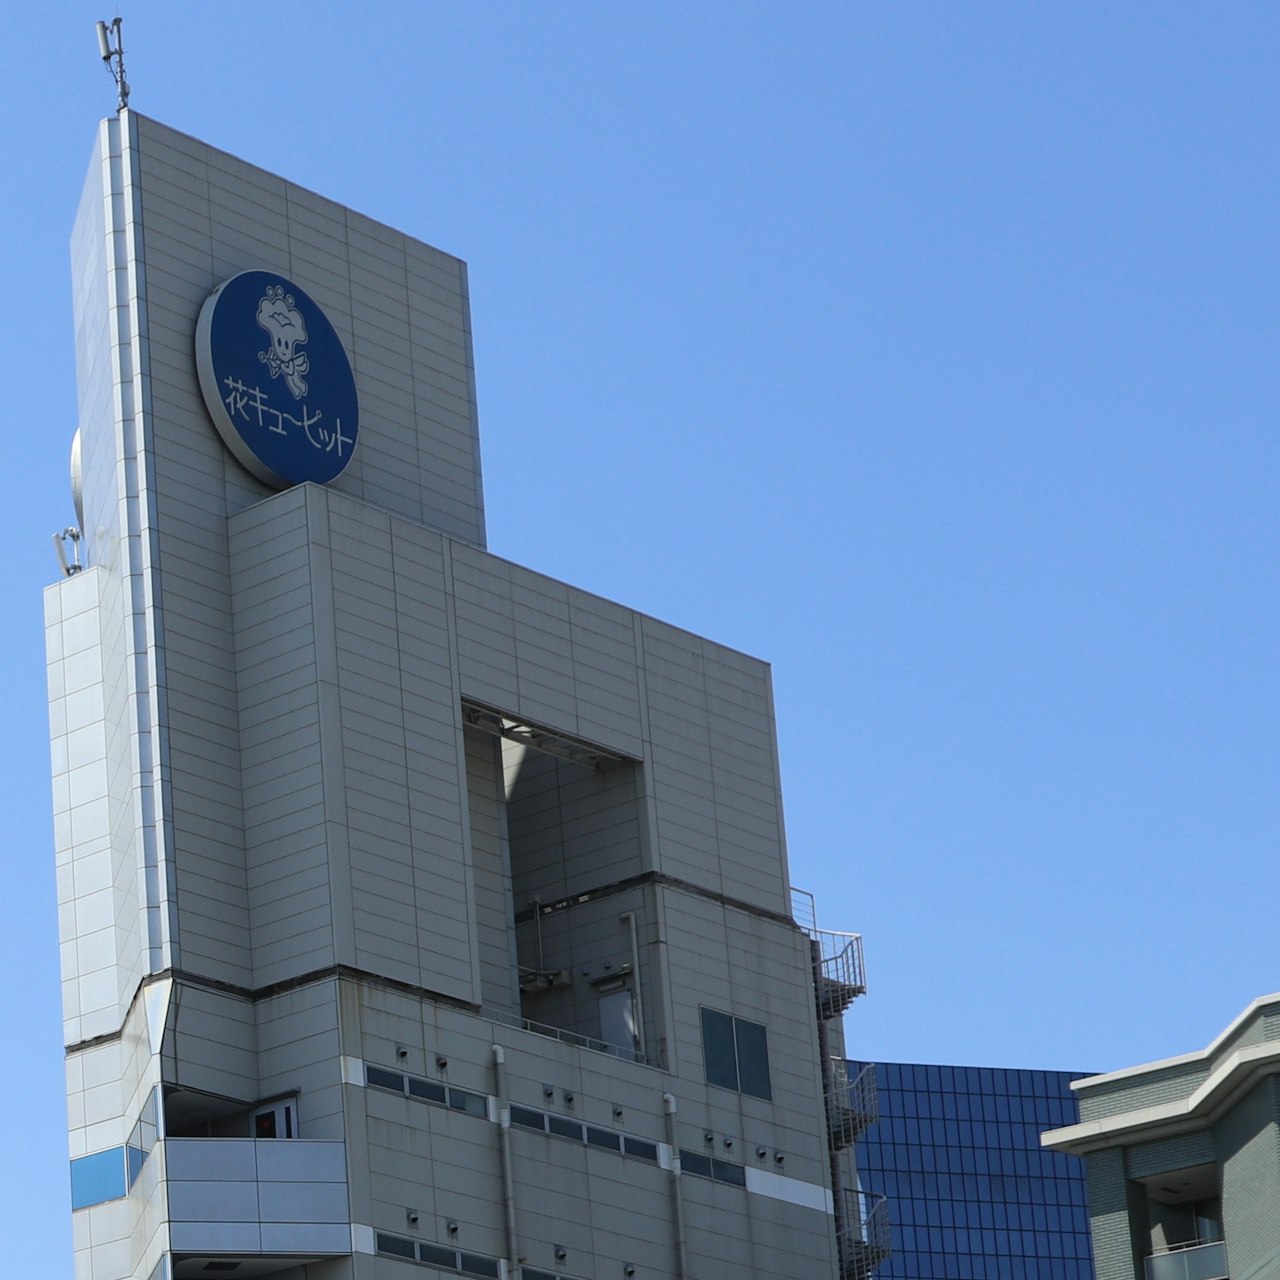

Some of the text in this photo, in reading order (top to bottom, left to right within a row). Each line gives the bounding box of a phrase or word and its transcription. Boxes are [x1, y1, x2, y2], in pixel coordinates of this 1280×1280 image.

[224, 375, 353, 457] 花キューピット
